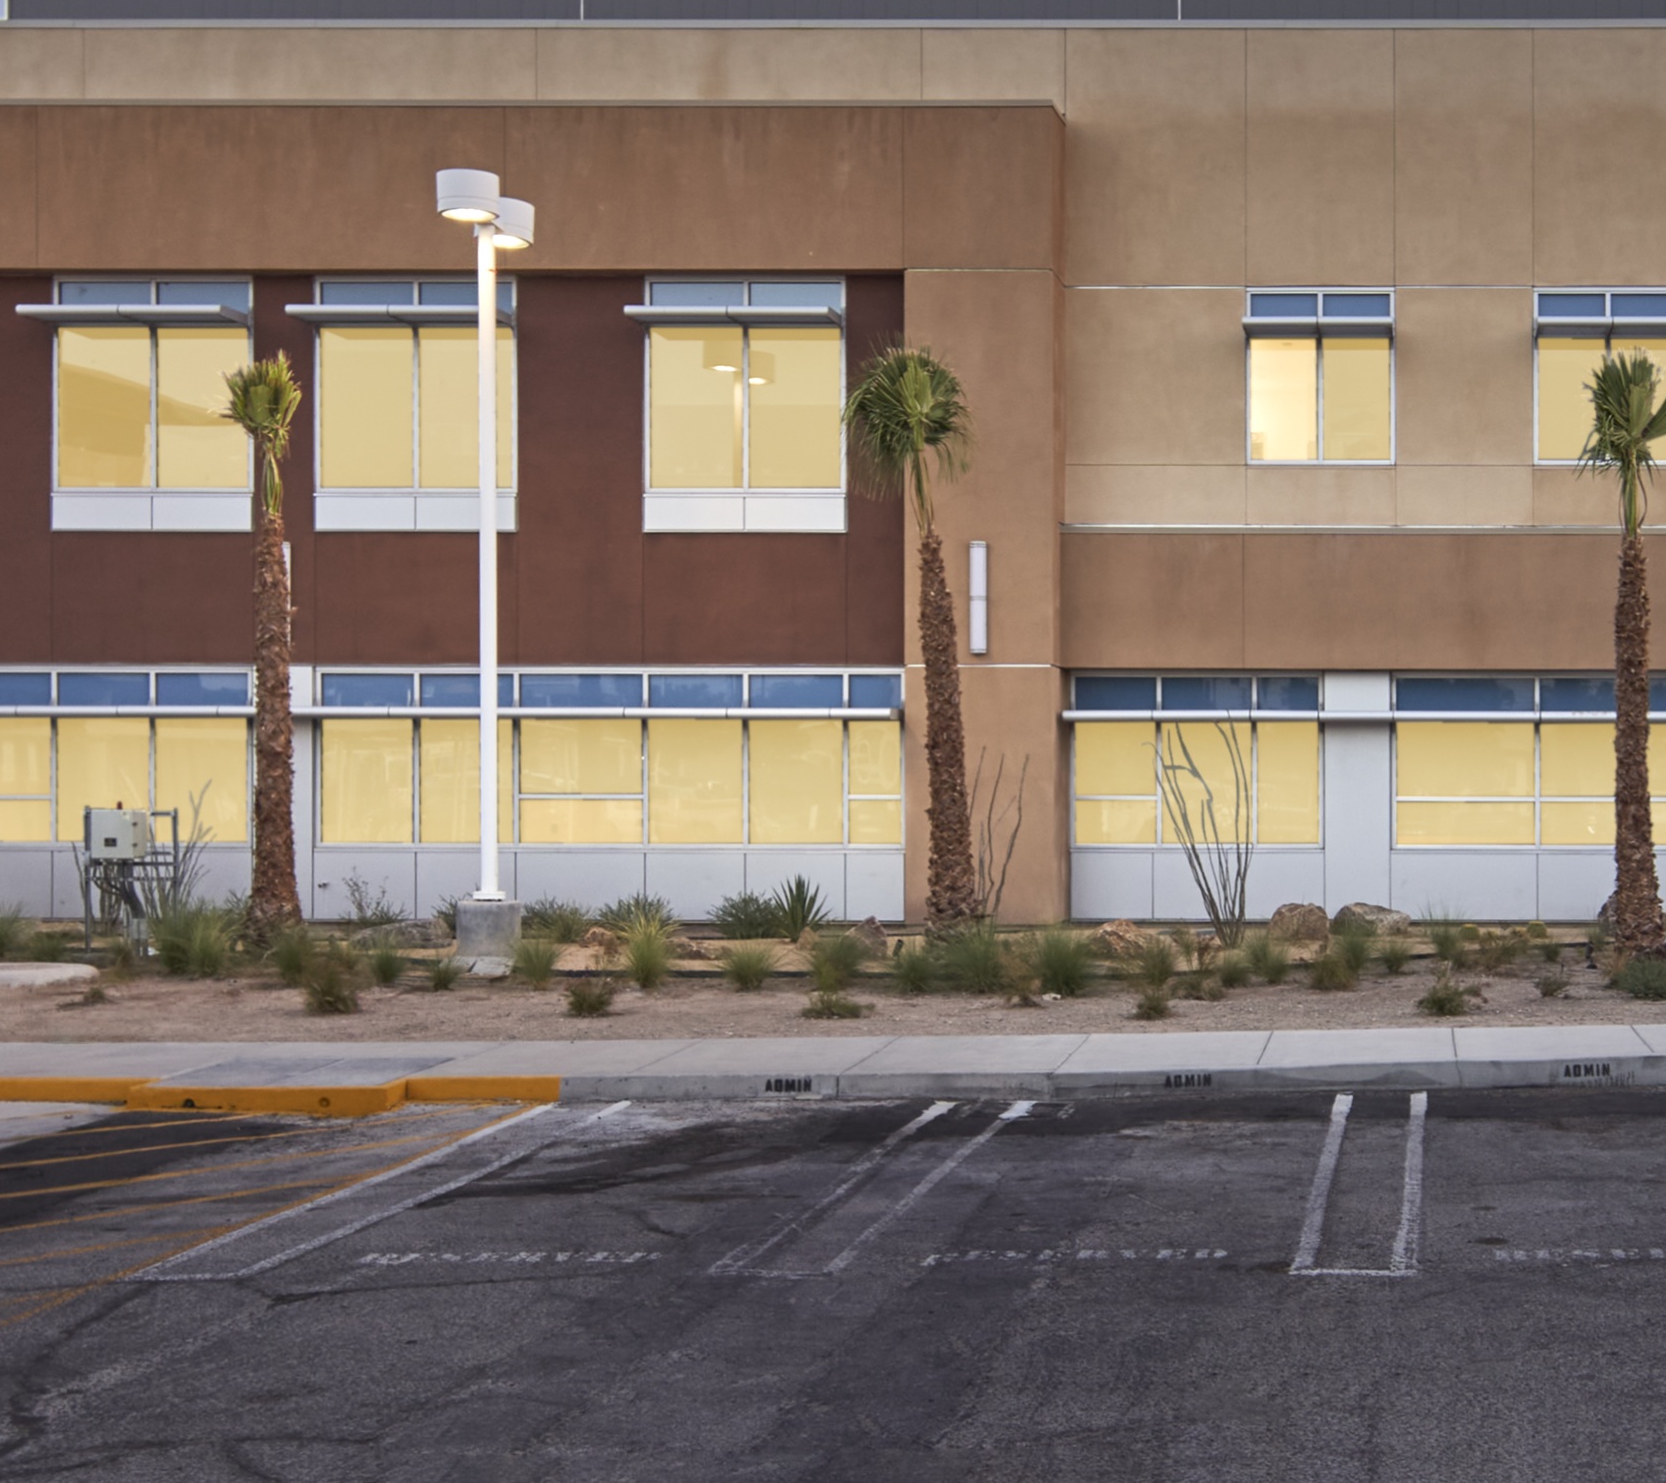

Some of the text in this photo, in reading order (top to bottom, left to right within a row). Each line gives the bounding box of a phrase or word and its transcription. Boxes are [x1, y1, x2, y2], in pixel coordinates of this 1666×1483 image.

[1564, 1064, 1611, 1078] ADMIN
[765, 1079, 812, 1093] ADMIN
[1165, 1074, 1211, 1088] ADMIN
